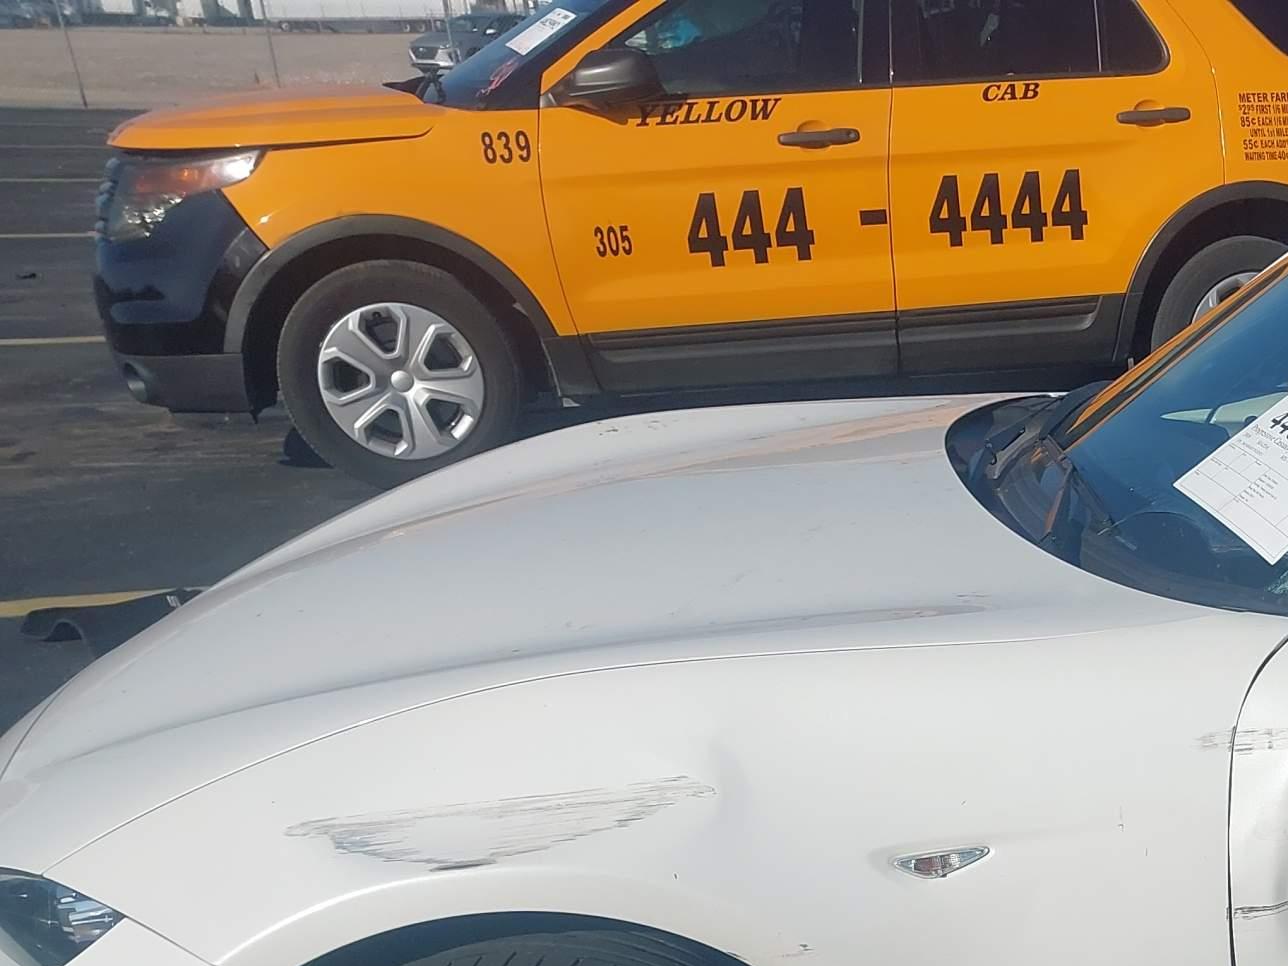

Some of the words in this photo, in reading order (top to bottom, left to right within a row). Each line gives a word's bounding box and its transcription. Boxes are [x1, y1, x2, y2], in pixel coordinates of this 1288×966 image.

[1239, 93, 1268, 103] METER
[636, 98, 782, 127] YELLOW
[981, 82, 1040, 103] CAB
[1256, 104, 1271, 114] FIRST
[1257, 116, 1273, 126] EACH
[481, 130, 531, 165] 839
[1260, 139, 1275, 149] EACH
[1244, 151, 1266, 161] WAITING
[593, 224, 633, 258] 305
[687, 187, 816, 268] 444
[928, 168, 1089, 248] 4444
